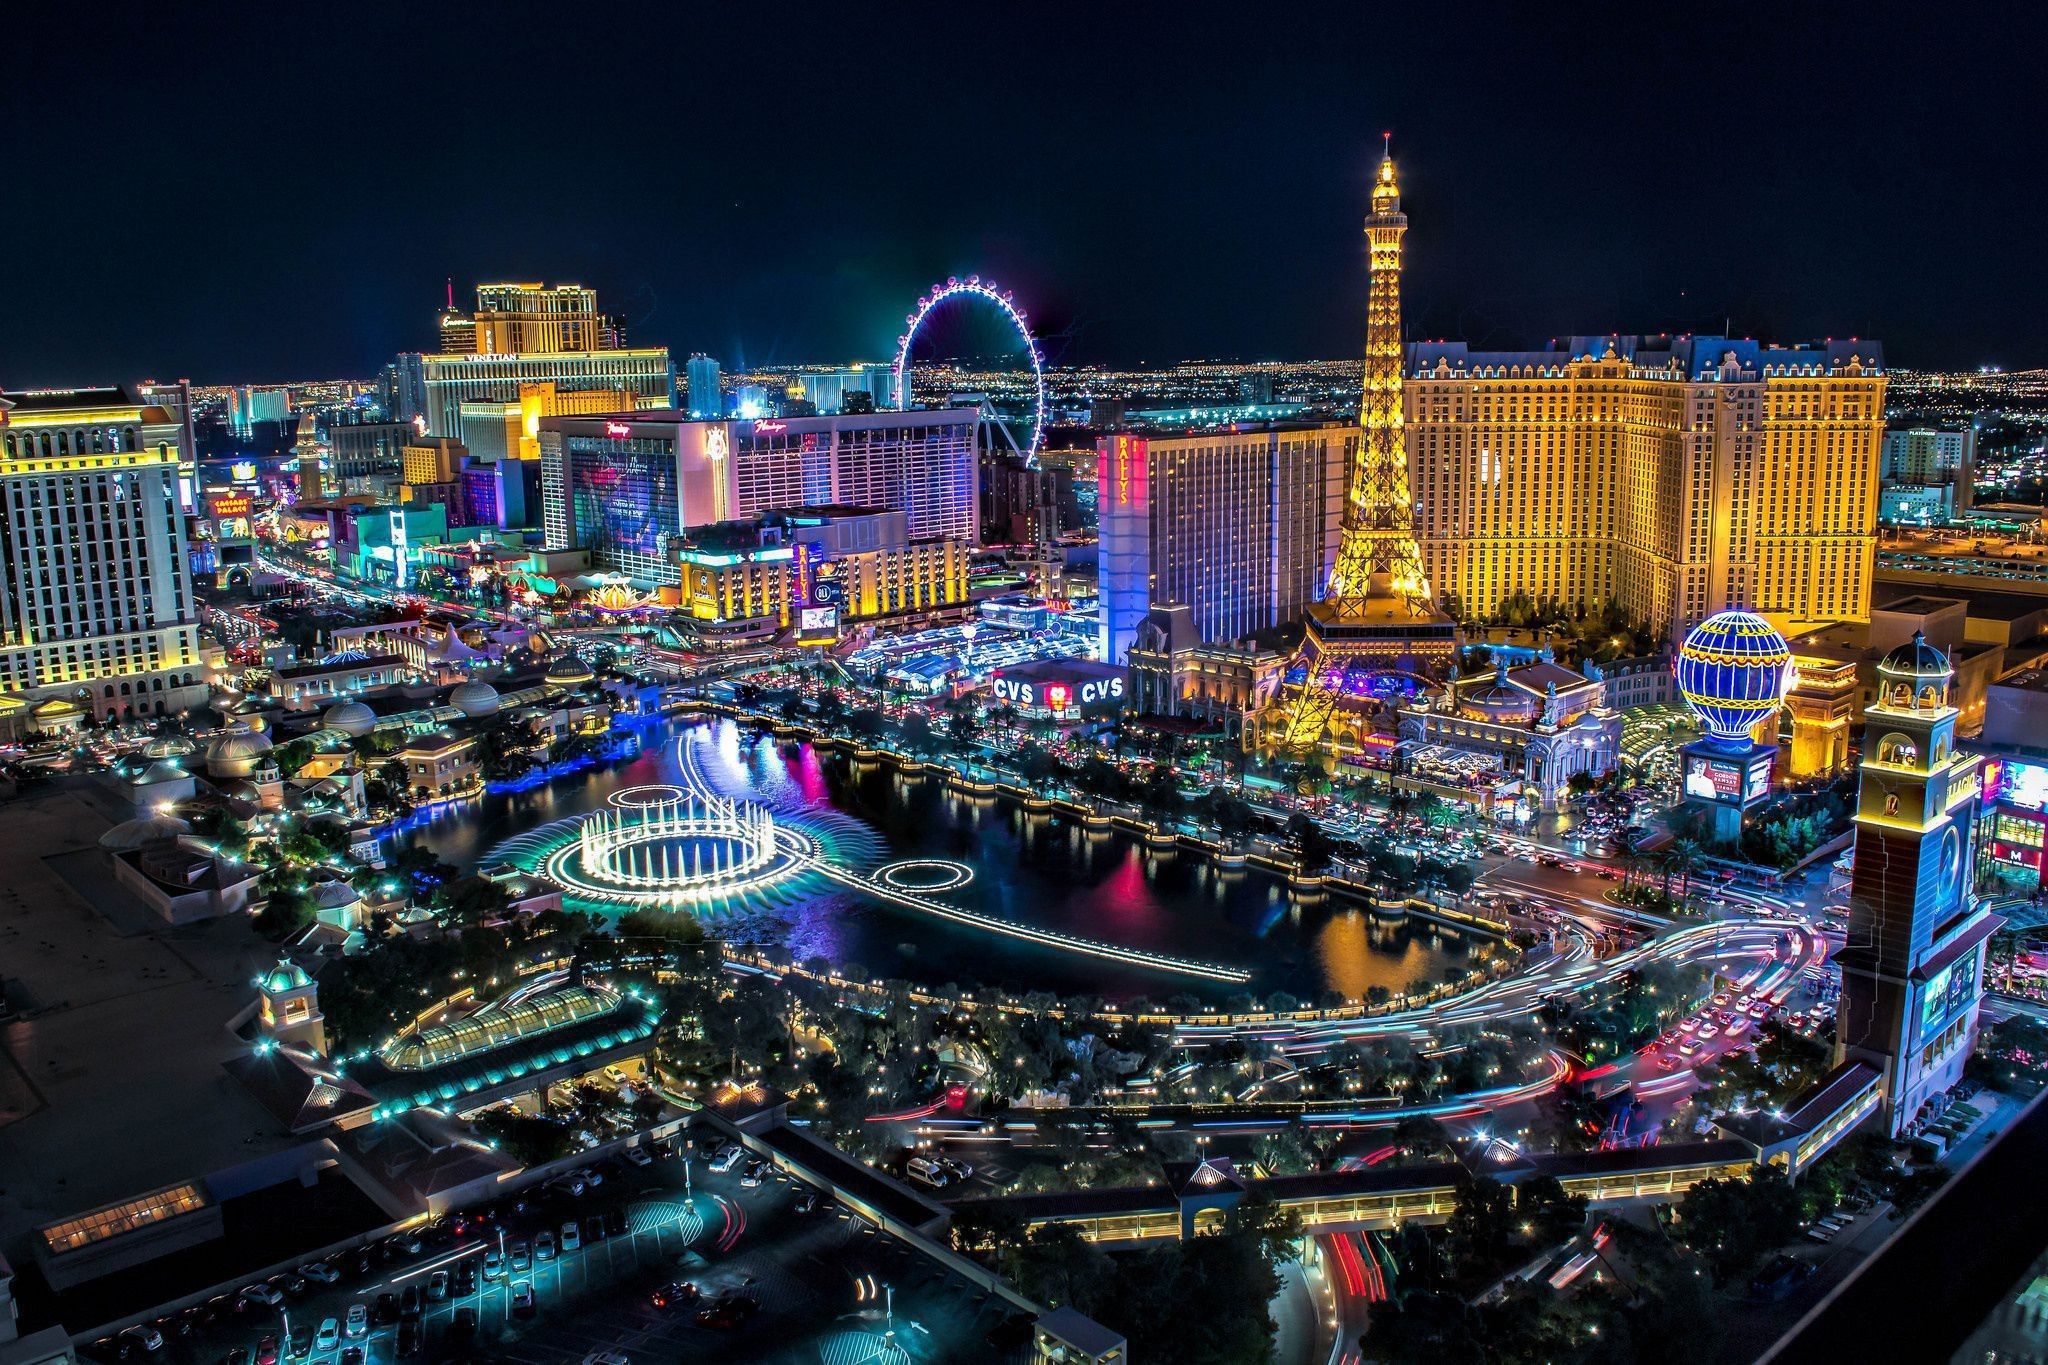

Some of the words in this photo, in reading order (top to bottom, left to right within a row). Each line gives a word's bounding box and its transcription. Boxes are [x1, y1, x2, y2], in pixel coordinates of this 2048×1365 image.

[467, 353, 517, 361] VENETIAN
[754, 419, 787, 433] Flamingo
[214, 499, 248, 508] CAESARS
[217, 505, 247, 514] PALACE
[993, 678, 1034, 704] CVS
[1081, 677, 1123, 703] CVS
[1364, 735, 1379, 744] BEER
[1379, 738, 1395, 747] PARK
[1714, 772, 1738, 781] GORDON
[1714, 777, 1737, 785] RAMSAY
